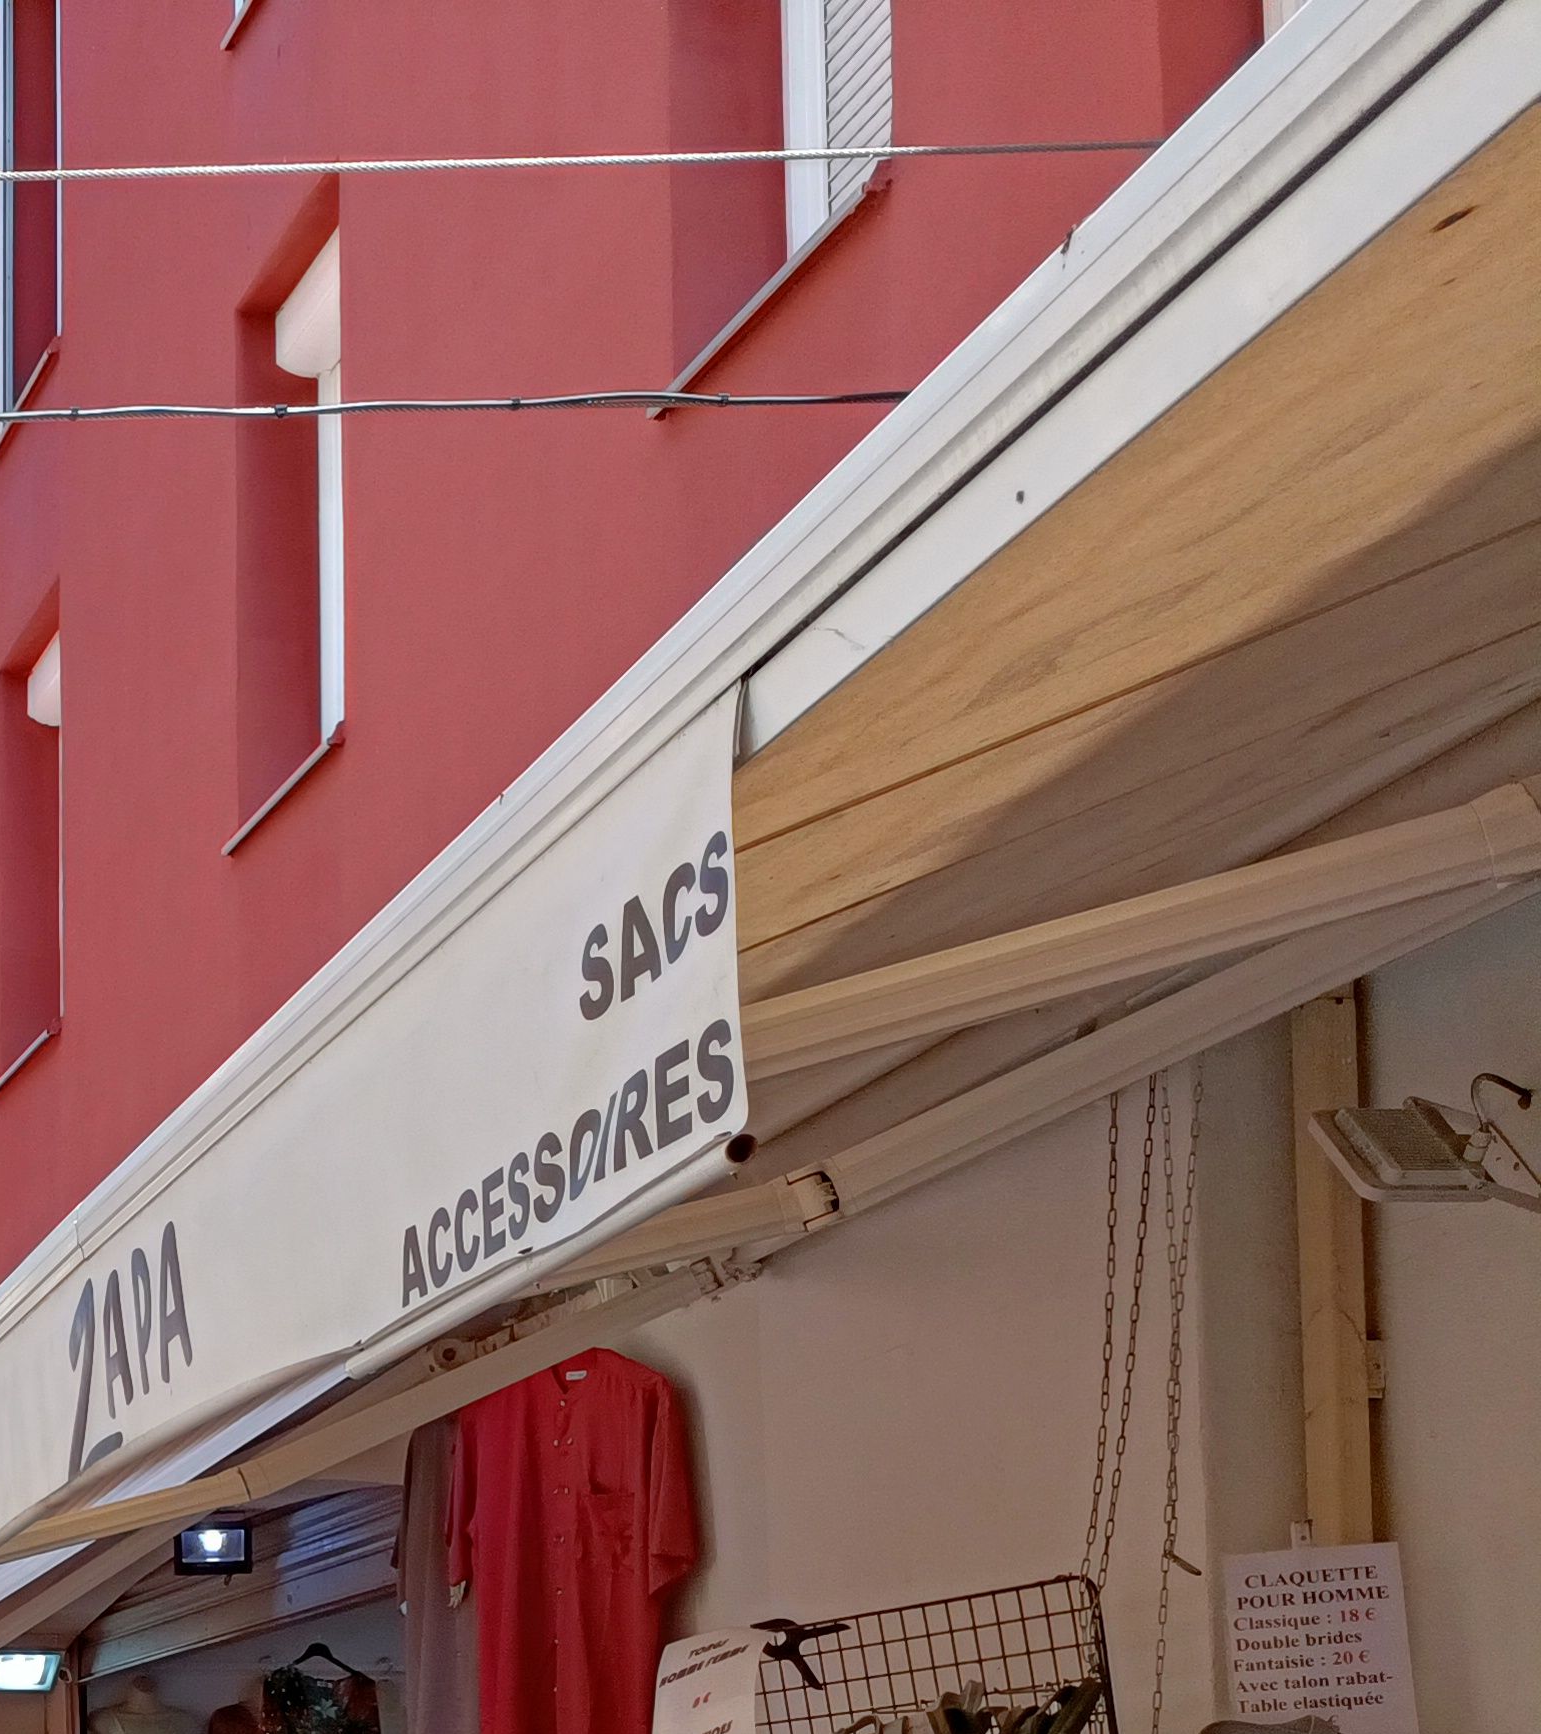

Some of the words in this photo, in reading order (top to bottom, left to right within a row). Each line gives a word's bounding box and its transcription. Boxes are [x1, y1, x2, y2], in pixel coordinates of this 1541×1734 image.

[578, 830, 730, 1022] SACS
[402, 1018, 736, 1308] ACCESSOIRES
[68, 1221, 193, 1484] ZAPA
[1244, 1564, 1379, 1589] CLAQUETTE
[1236, 1592, 1296, 1611] POUR
[1301, 1585, 1390, 1605] HOMME
[1233, 1613, 1321, 1632] Classique
[1339, 1608, 1360, 1624] 18
[1364, 1607, 1377, 1621] €
[1235, 1635, 1300, 1652] Double
[1305, 1630, 1363, 1647] brides
[1233, 1654, 1315, 1673] Fantaisie
[1332, 1650, 1354, 1666] 20
[1358, 1649, 1371, 1664] €
[1235, 1678, 1279, 1693] Avec
[1284, 1675, 1330, 1690] talon
[1335, 1670, 1394, 1687] rabat-
